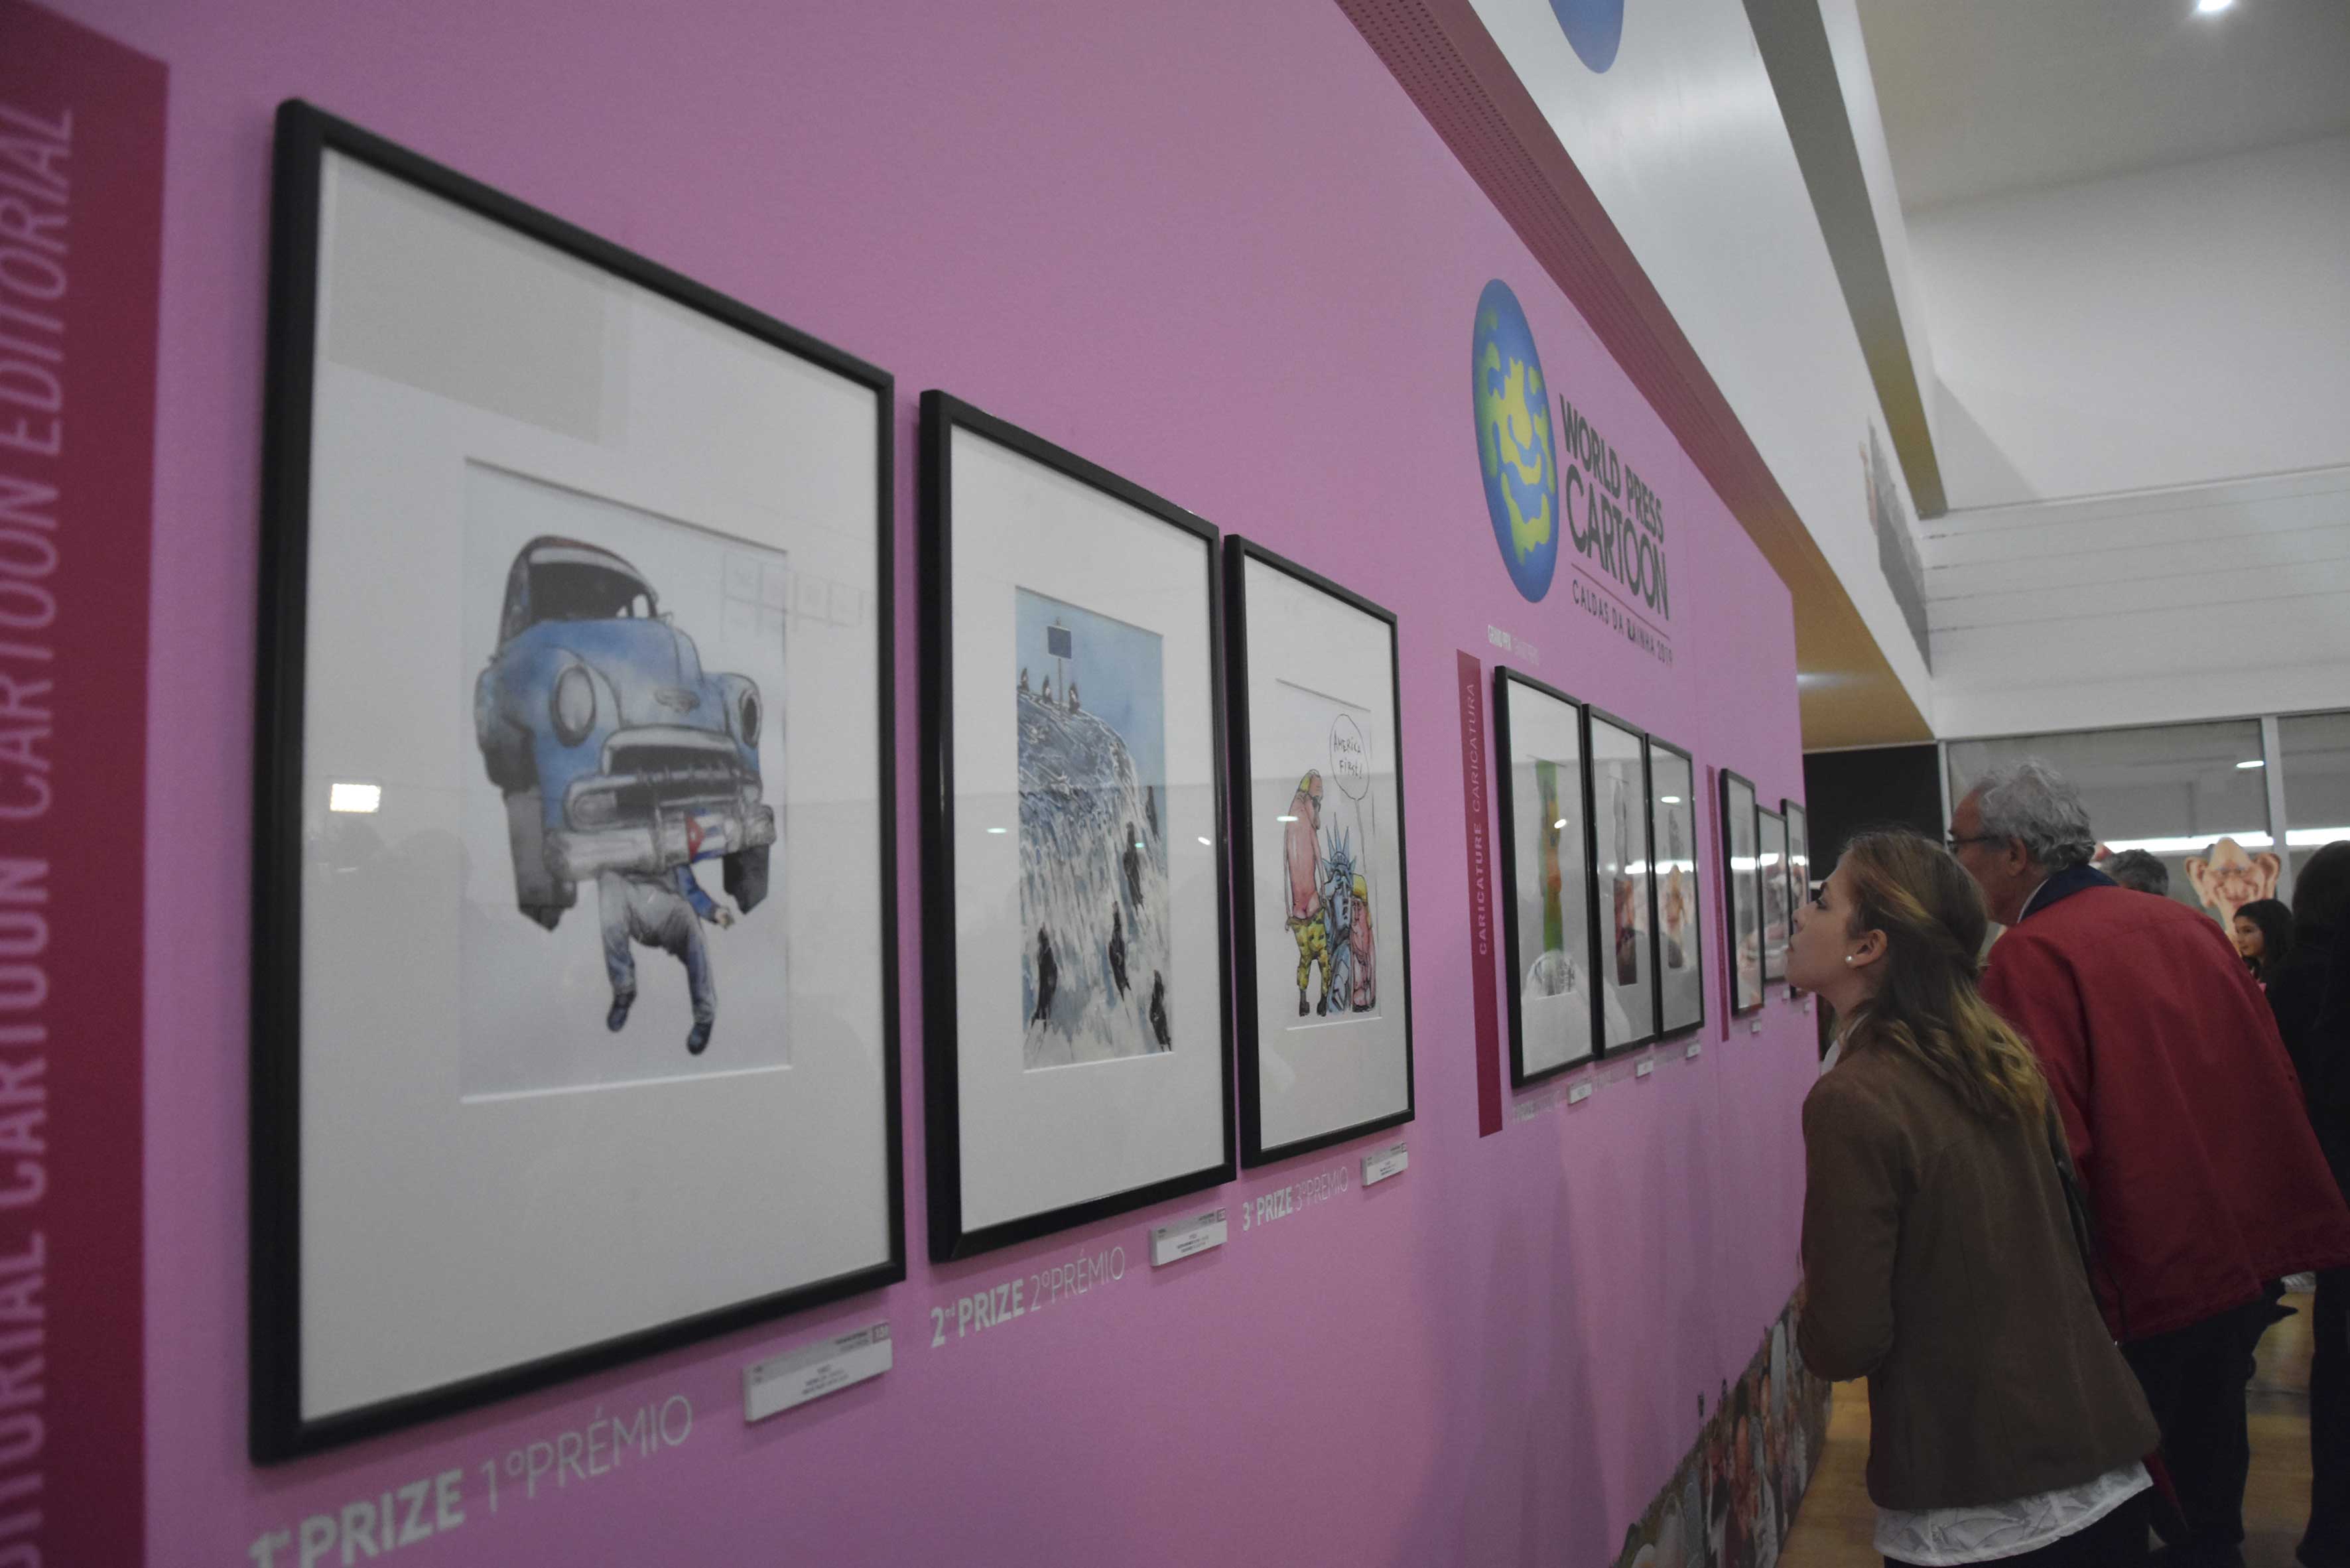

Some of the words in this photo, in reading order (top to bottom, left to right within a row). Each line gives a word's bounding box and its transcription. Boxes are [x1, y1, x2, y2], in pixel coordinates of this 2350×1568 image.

[1559, 393, 1621, 499] WORLD
[1625, 463, 1664, 544] PRESS
[1566, 464, 1669, 621] CARTOON
[1573, 579, 1608, 625] CALDAS
[1612, 606, 1624, 635] DA
[1466, 684, 1481, 813] CARICATURA
[1474, 822, 1487, 955] CARICATURE
[1257, 1186, 1293, 1226] PRIZE
[958, 1278, 1025, 1338] PRIZE
[298, 1469, 466, 1568] PRIZE
